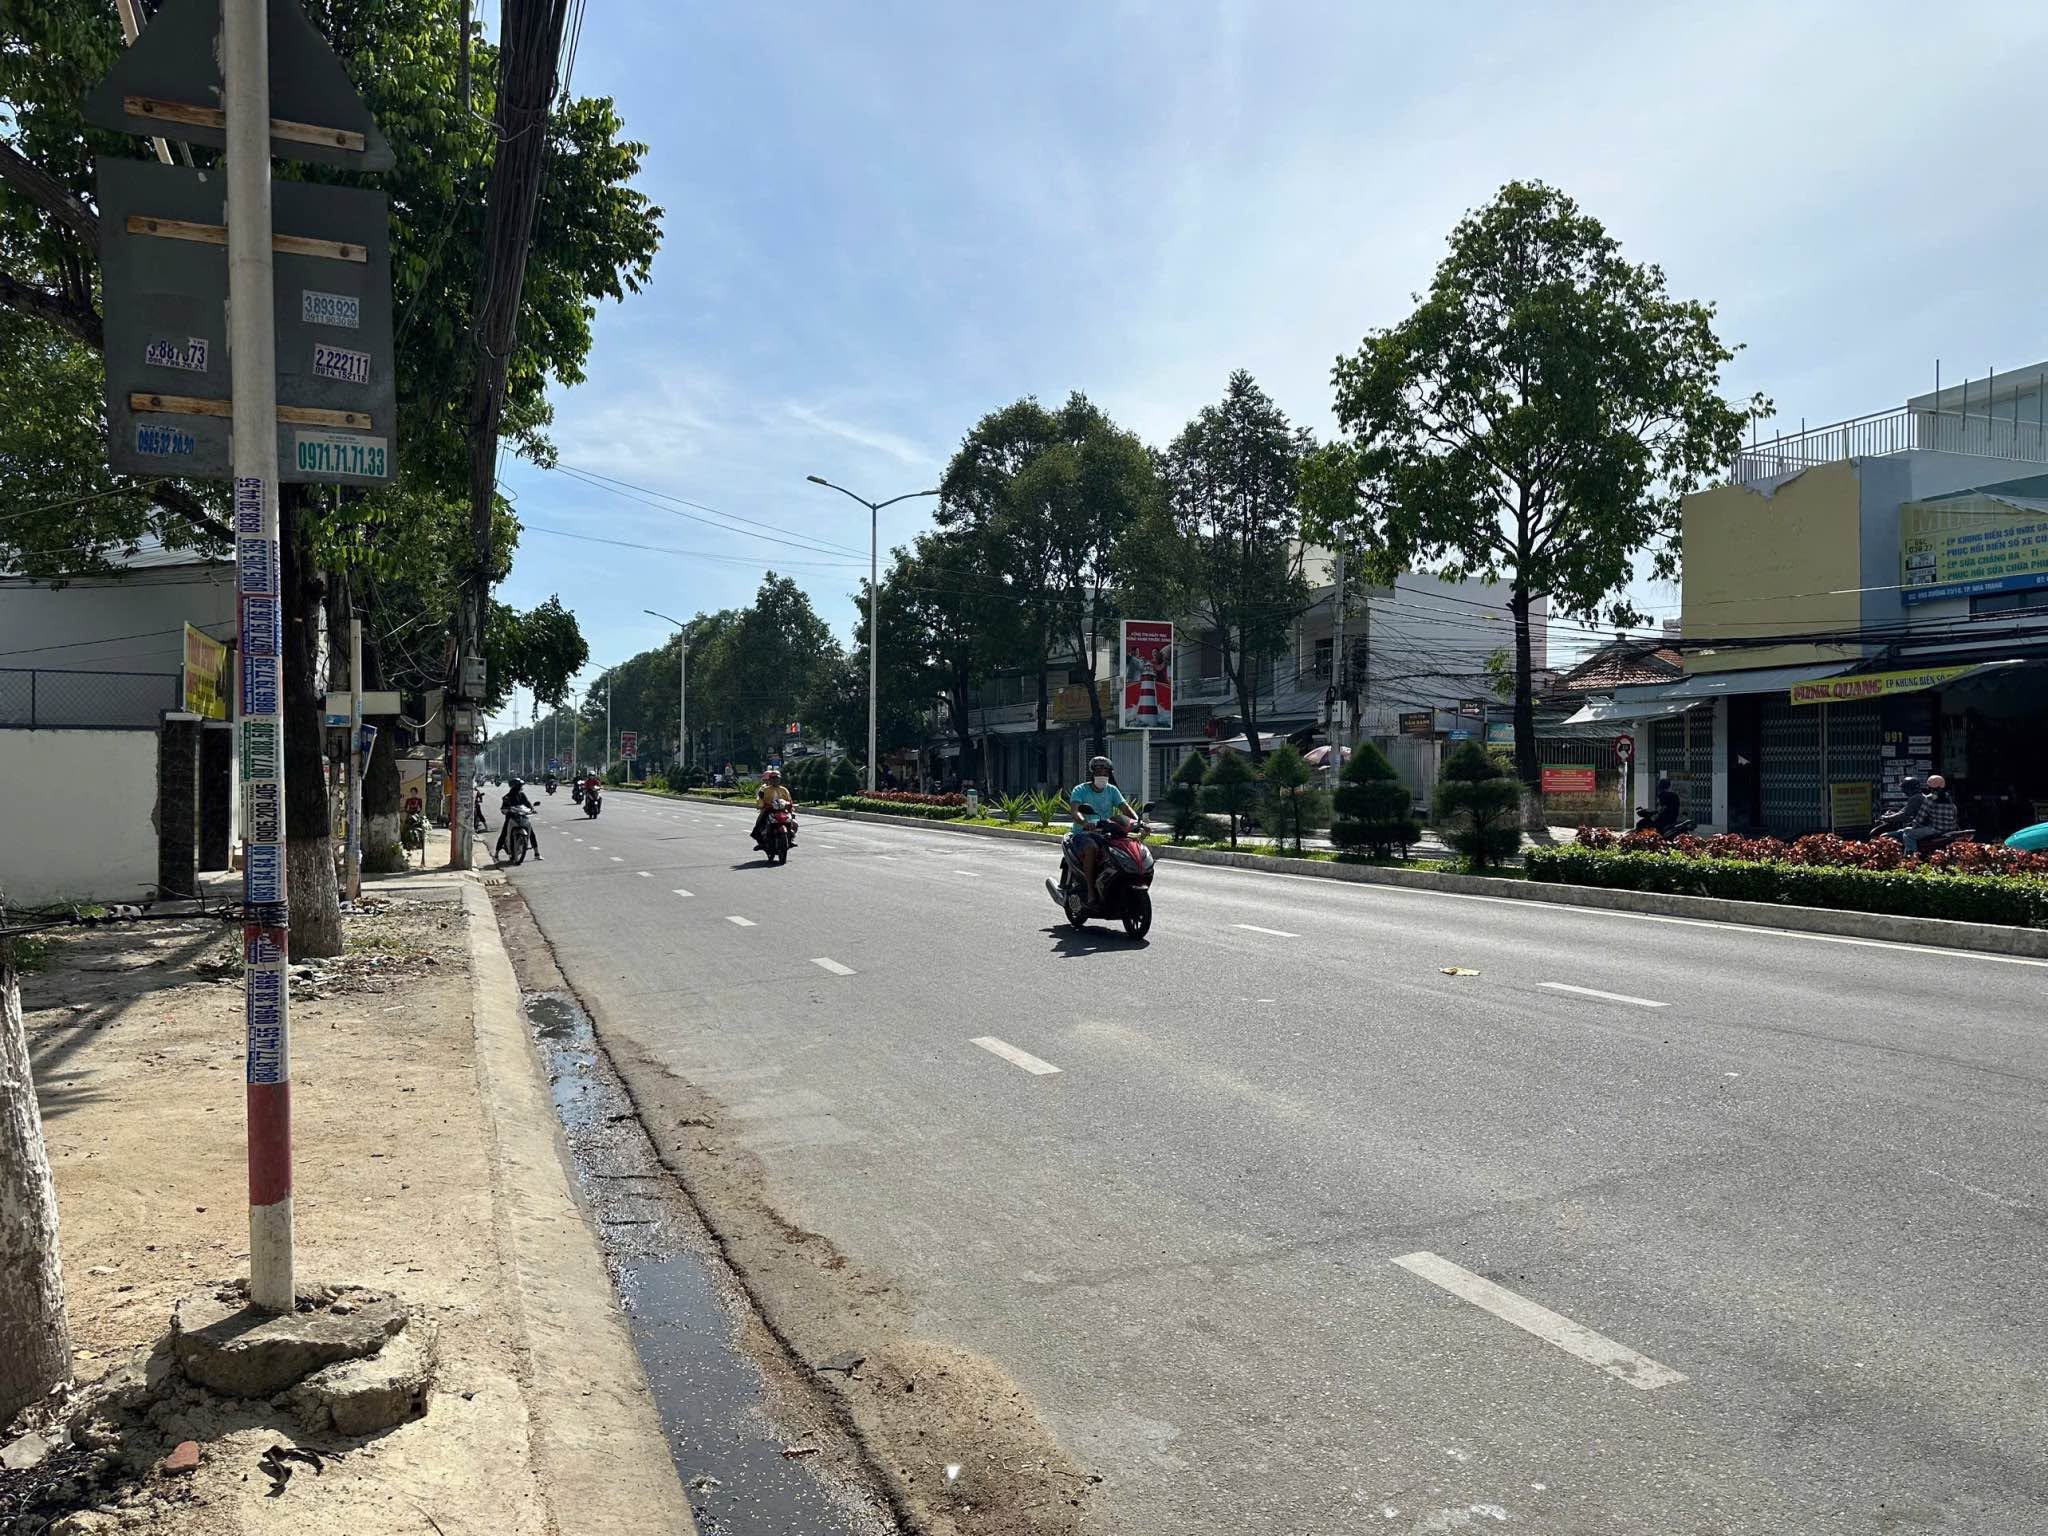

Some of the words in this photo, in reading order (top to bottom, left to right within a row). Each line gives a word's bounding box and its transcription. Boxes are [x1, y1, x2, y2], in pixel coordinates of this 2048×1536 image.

[298, 441, 385, 475] 0971.71.71.33
[239, 478, 261, 533] 0938.30.44.55
[242, 539, 267, 592] 0905.205.359
[250, 598, 273, 653] 0971.05.06.60
[255, 658, 276, 713] 0866.79.77.39
[251, 723, 274, 778] 0977.808.508
[1885, 730, 1904, 743] 991
[255, 784, 278, 842] 0905.209.405
[253, 846, 276, 901] 0931.64.64.80
[256, 1028, 279, 1083] 0848.77.44.55
